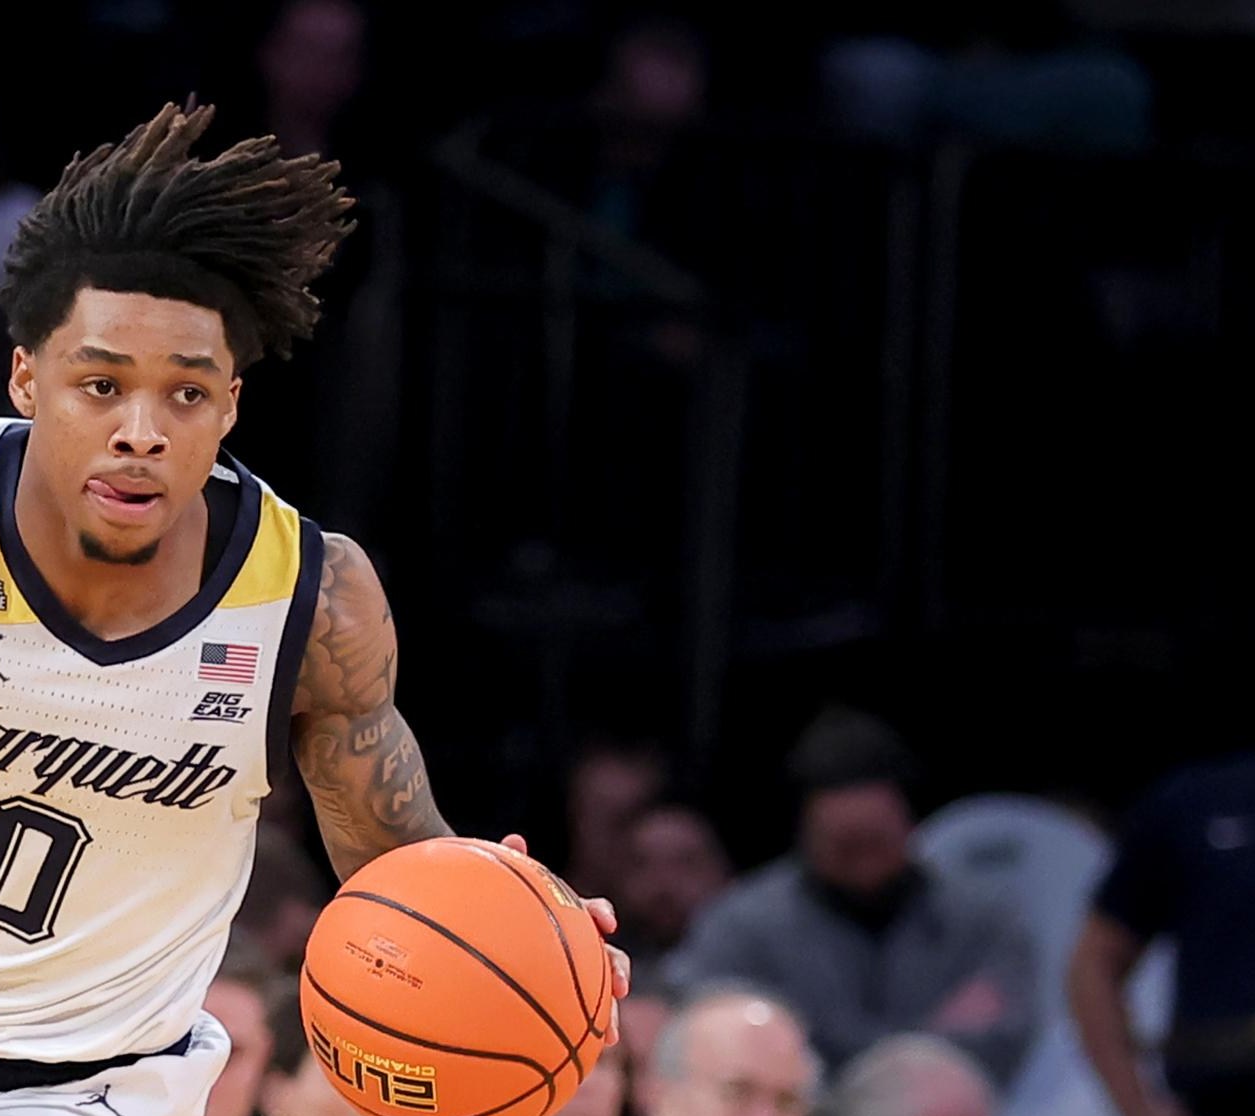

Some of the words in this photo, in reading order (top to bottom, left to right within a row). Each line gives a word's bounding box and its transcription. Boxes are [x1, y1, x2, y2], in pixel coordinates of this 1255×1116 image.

[192, 703, 253, 719] EAST
[201, 691, 245, 706] BIG
[310, 1021, 438, 1113] ELITE
[329, 1028, 436, 1077] CHAMPION
